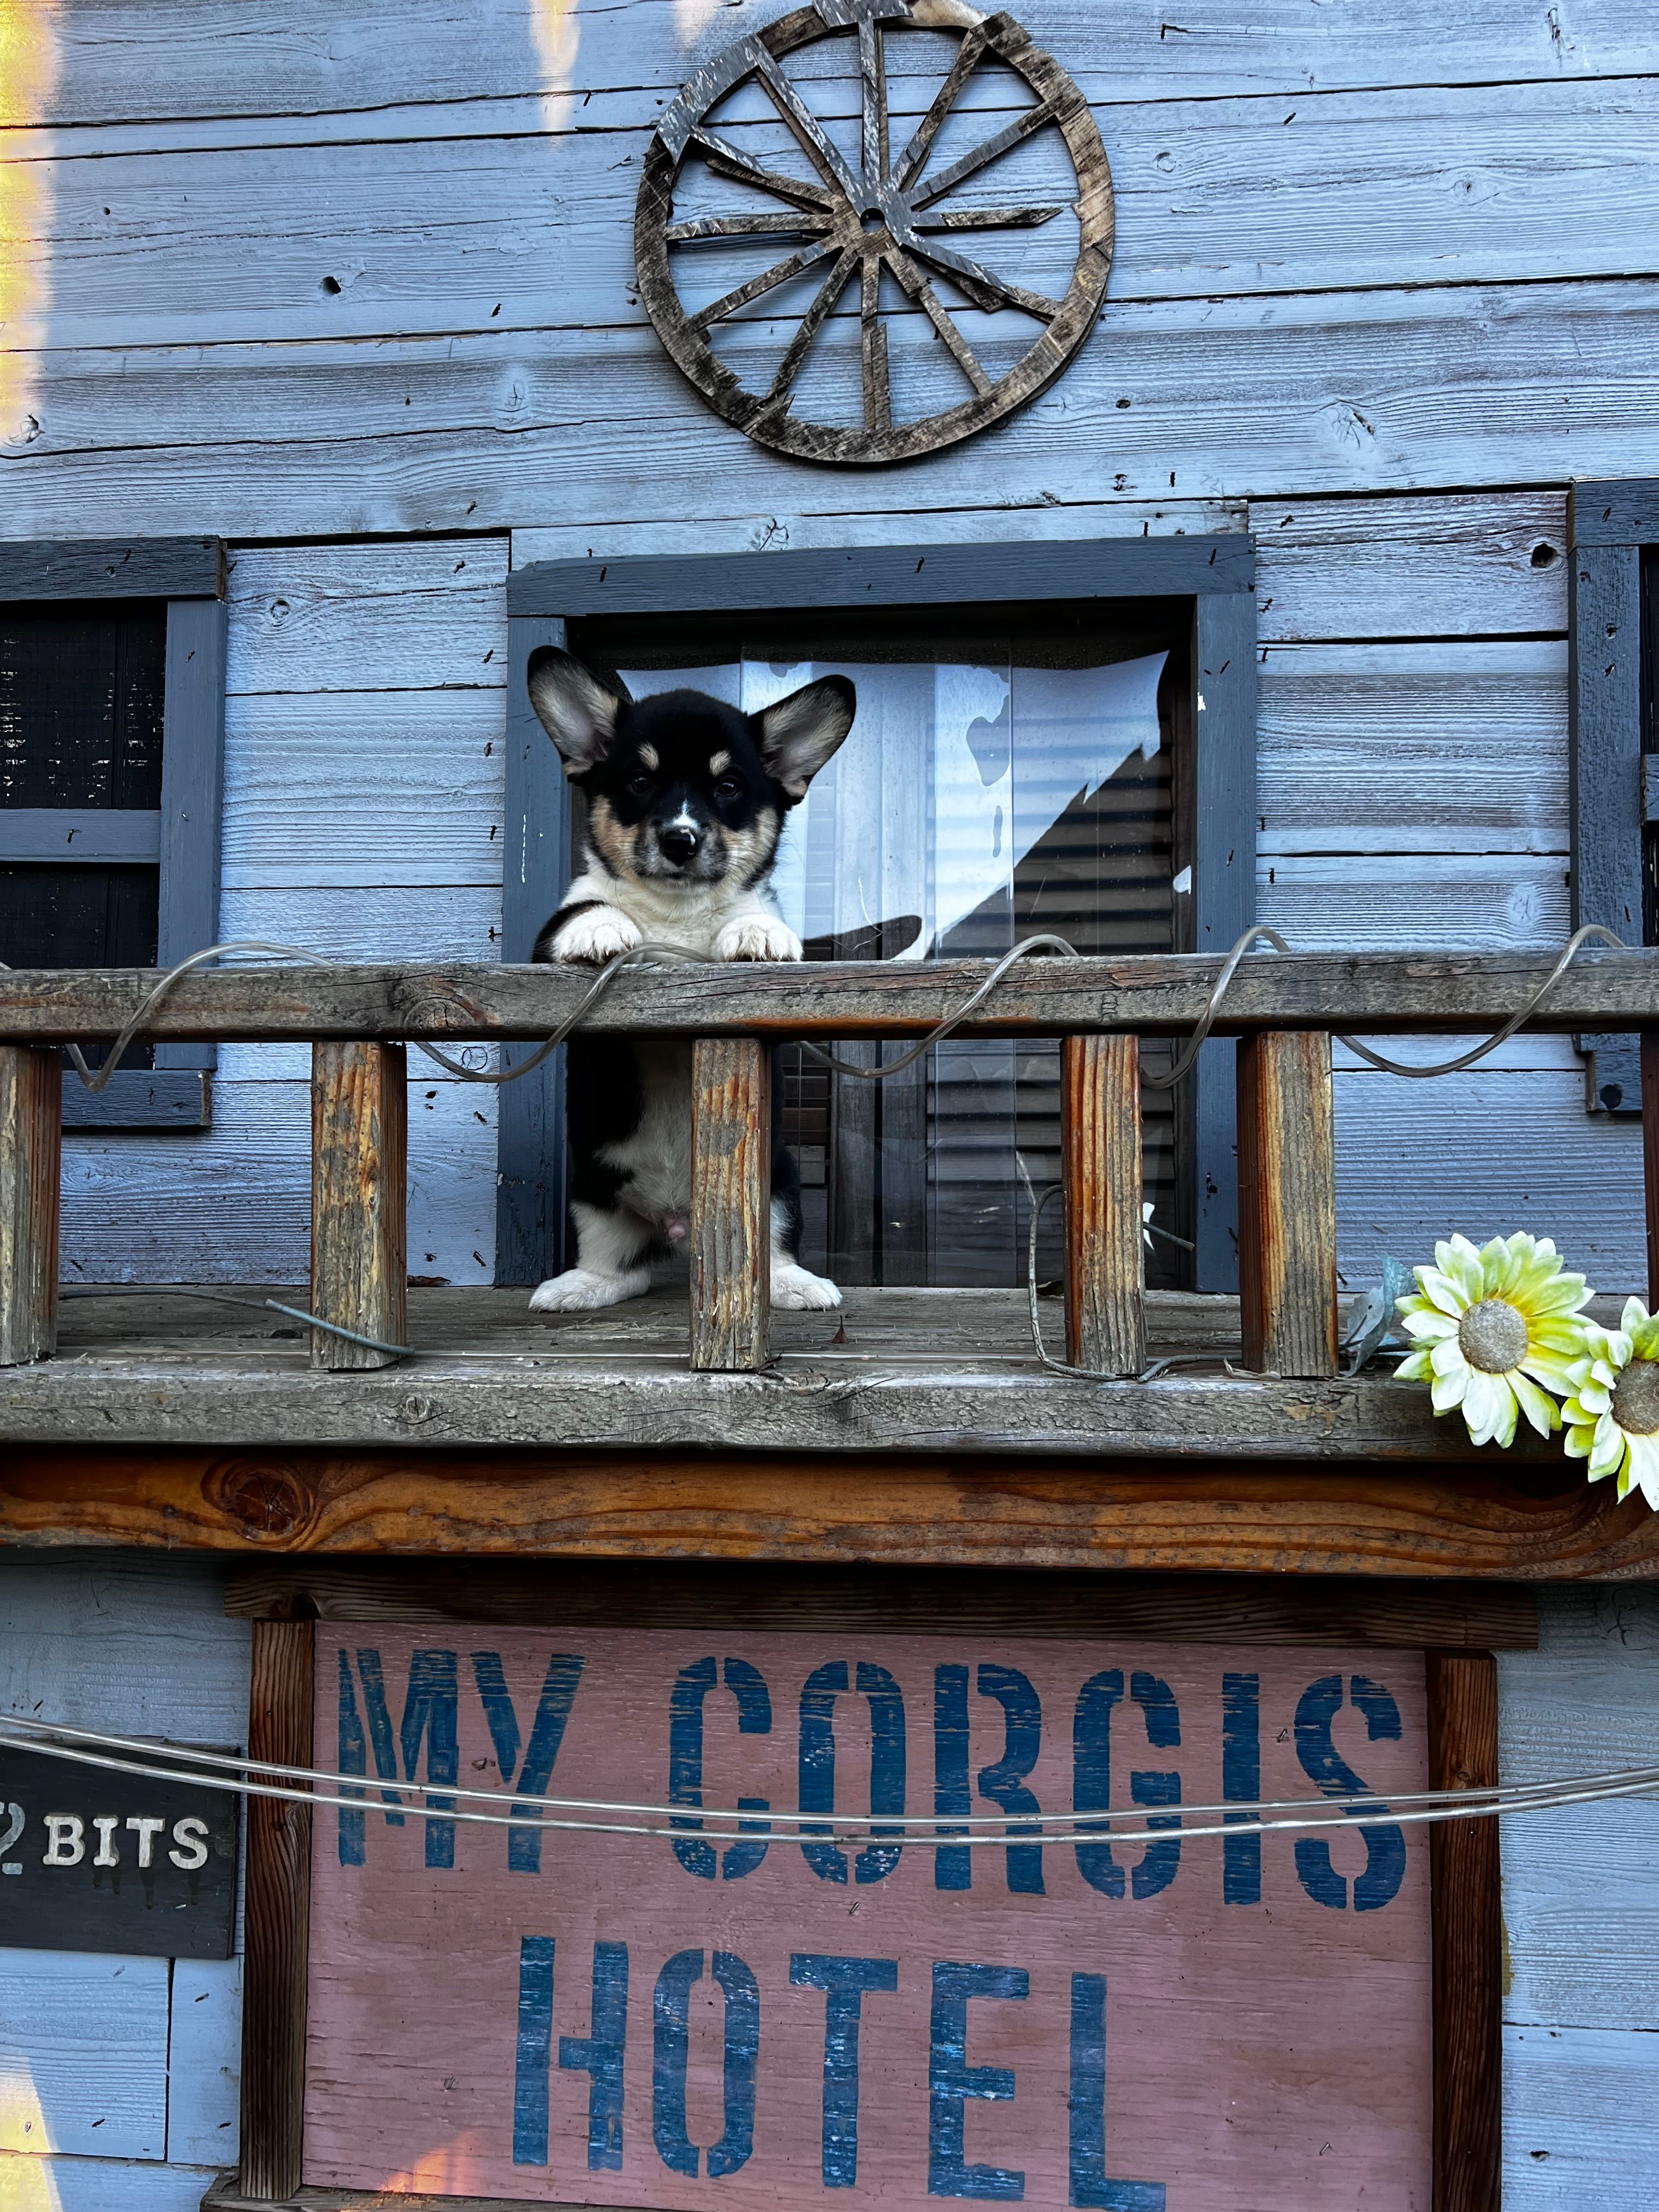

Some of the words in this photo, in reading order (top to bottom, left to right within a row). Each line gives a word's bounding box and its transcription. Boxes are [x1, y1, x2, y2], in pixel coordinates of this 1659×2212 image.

[42, 1813, 211, 1870] BITS
[336, 1648, 585, 1874] MY
[668, 1656, 1407, 1911] CORGIS
[512, 1934, 1166, 2211] HOTEL
